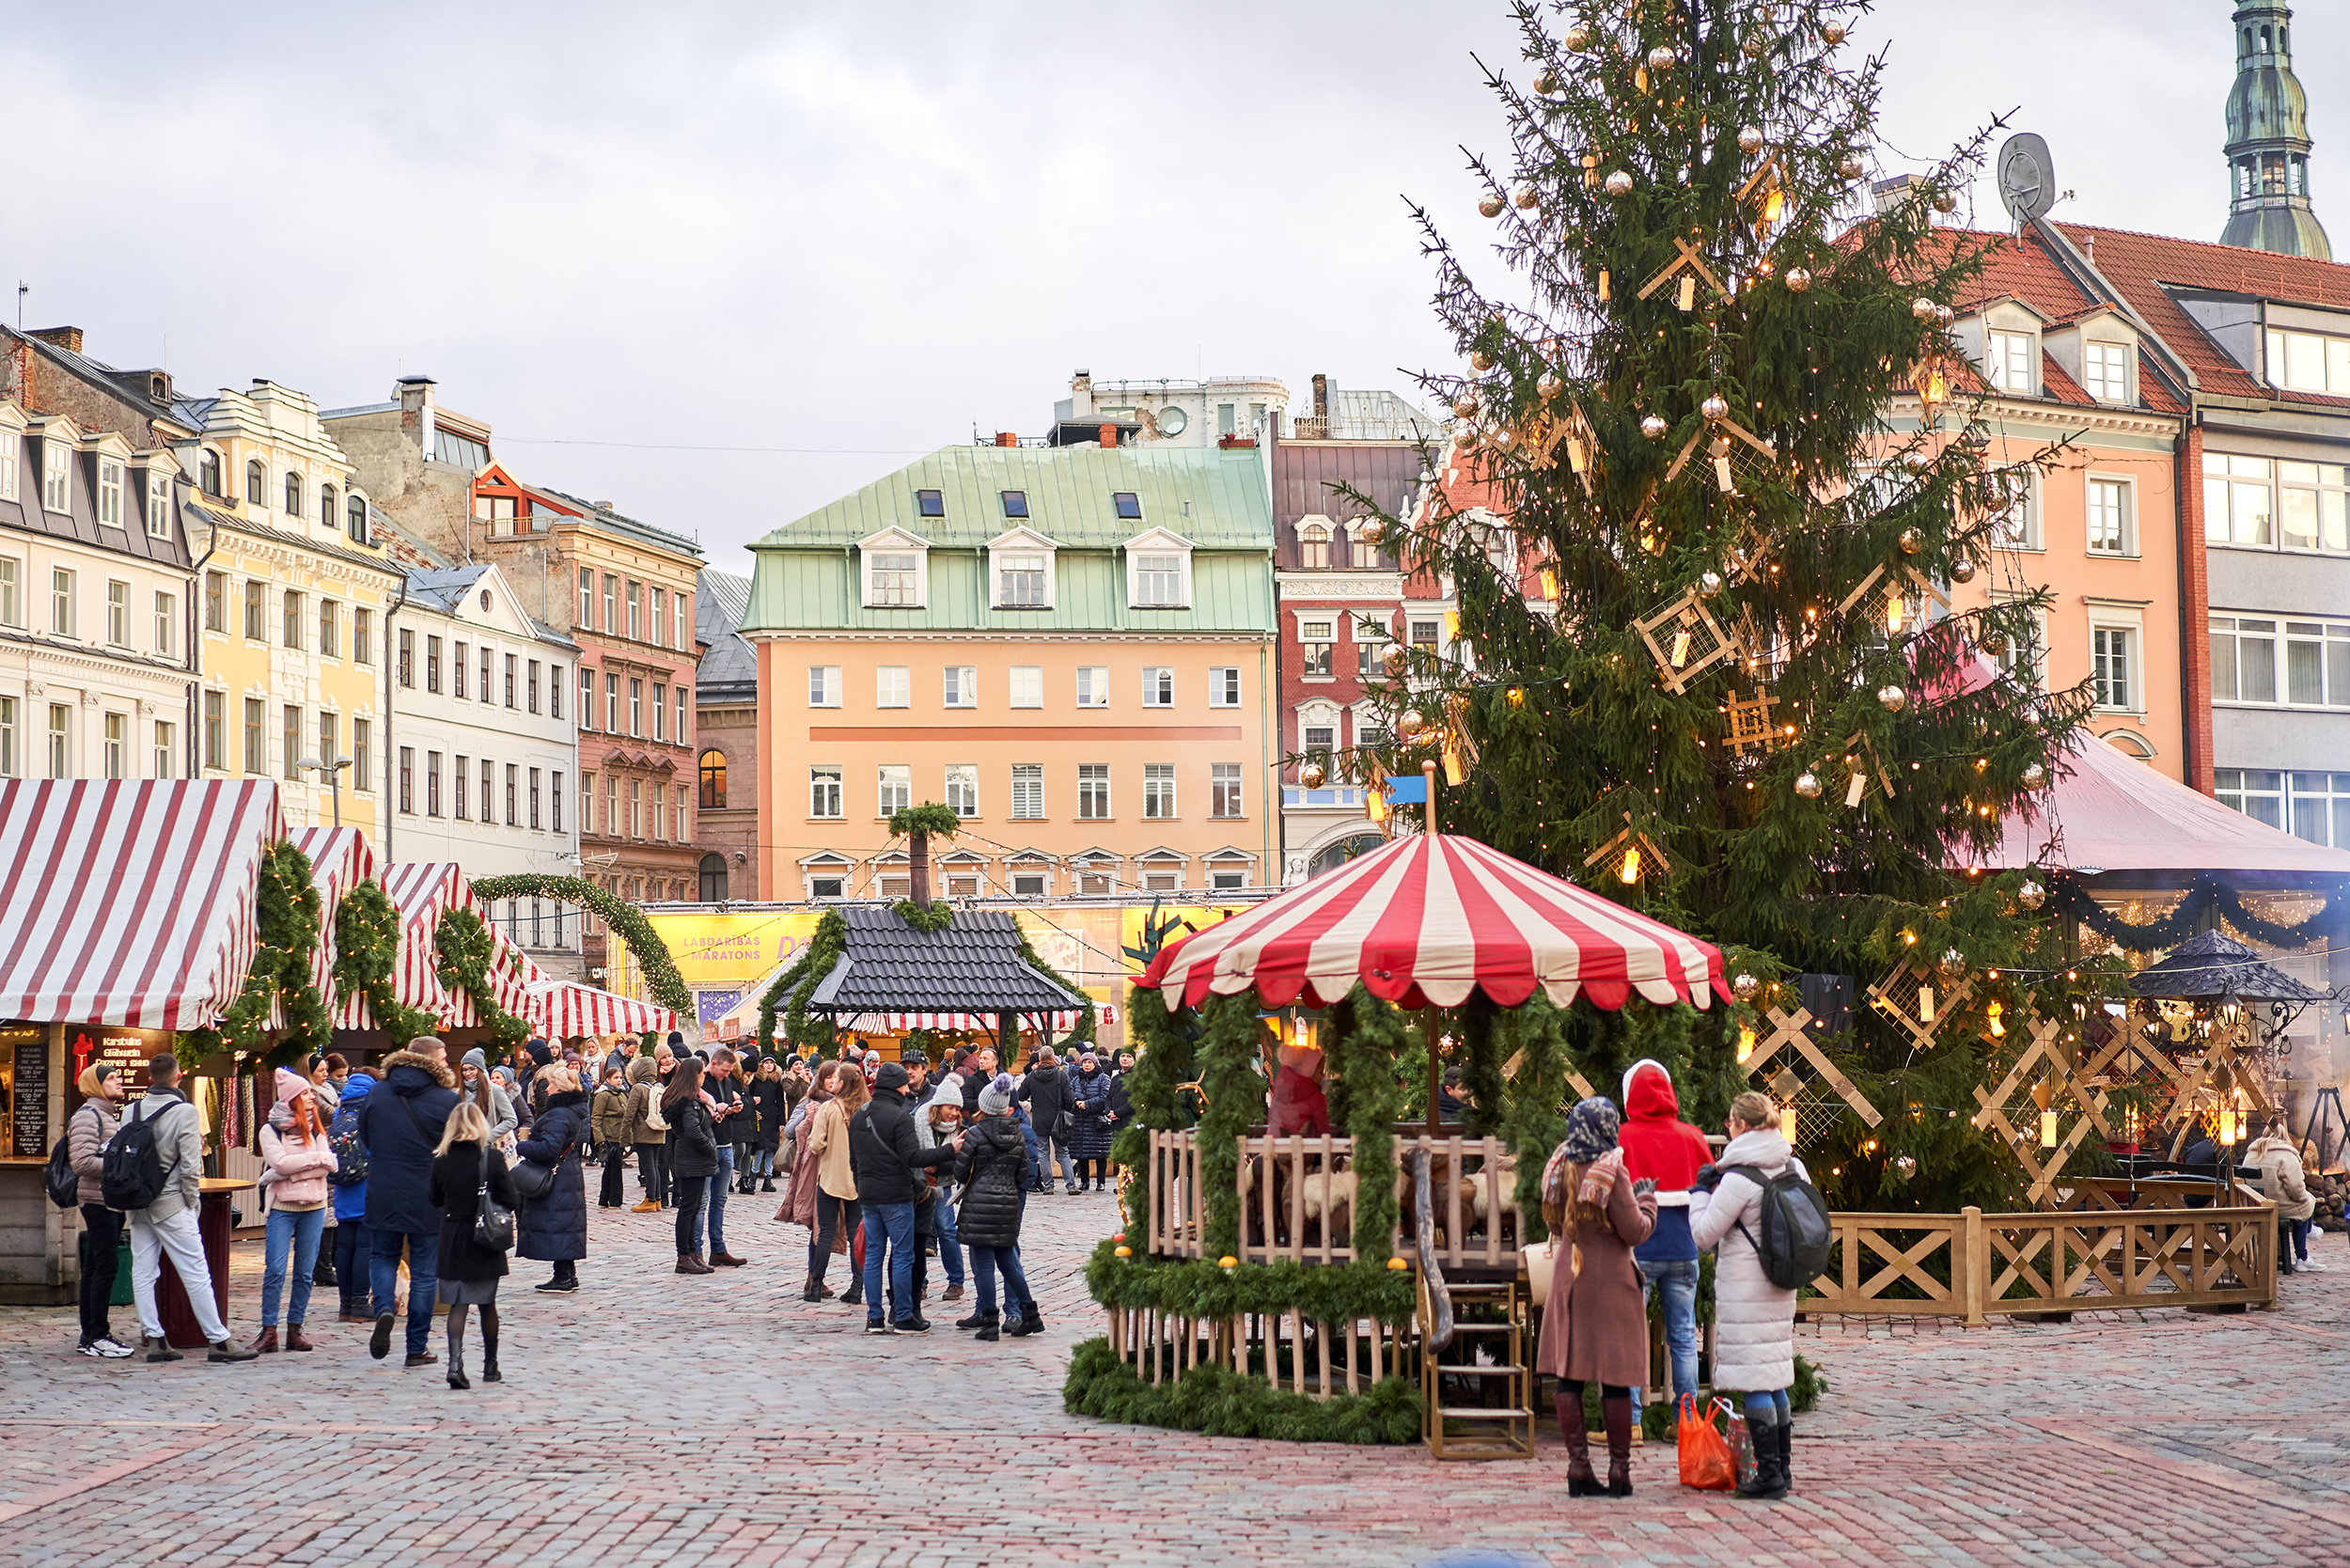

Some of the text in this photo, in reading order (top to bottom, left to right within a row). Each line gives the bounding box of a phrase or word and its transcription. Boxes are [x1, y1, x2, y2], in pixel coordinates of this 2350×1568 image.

[683, 934, 760, 947] LABDARĪBAS
[692, 950, 760, 960] MARATONS
[103, 1048, 140, 1058] Glühwein
